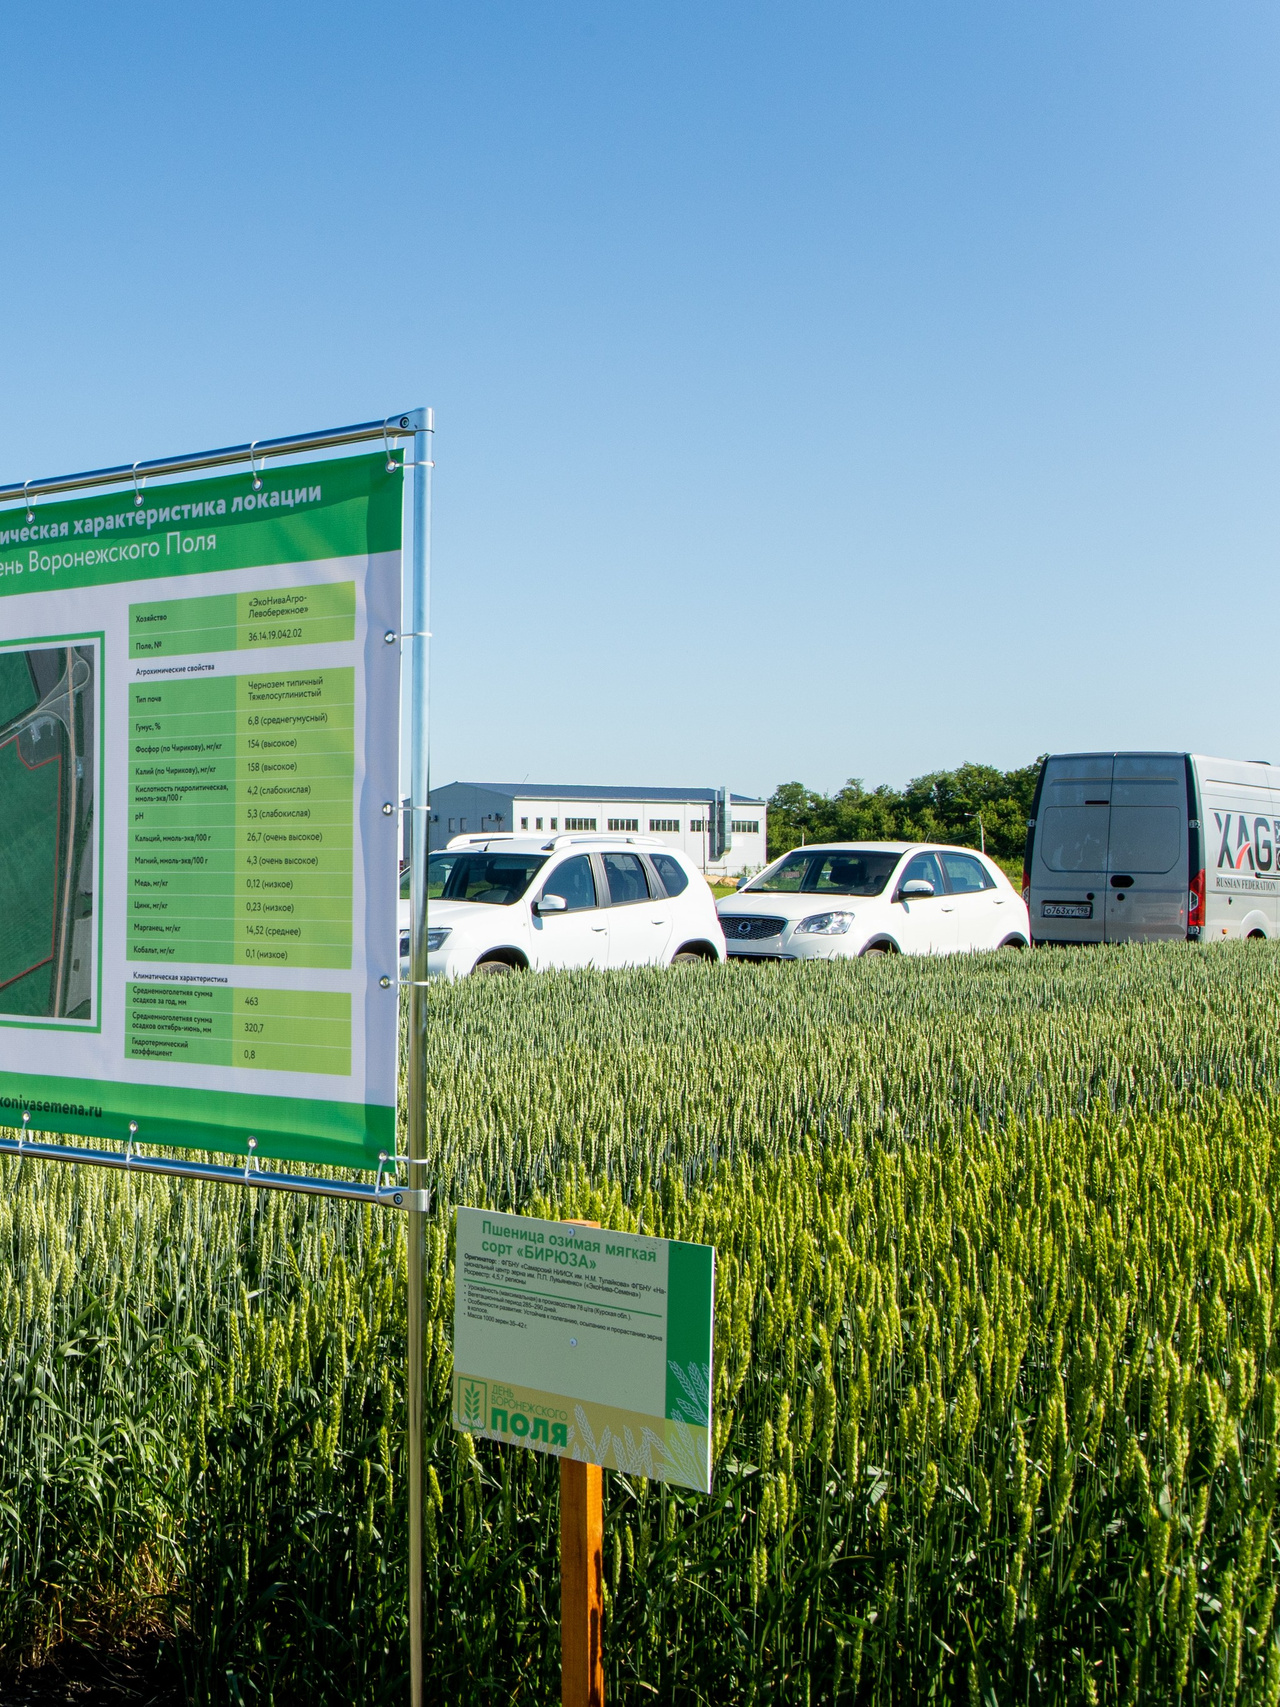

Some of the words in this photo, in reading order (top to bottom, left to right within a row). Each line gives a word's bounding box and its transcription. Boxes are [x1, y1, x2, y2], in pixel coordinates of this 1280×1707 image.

[73, 495, 226, 537] характеристика
[231, 485, 321, 512] локации
[28, 538, 160, 574] Воронежского
[166, 531, 216, 554] Поля
[249, 595, 307, 607] «ЭкоНиваАгро-
[249, 605, 308, 619] Левобережное»
[136, 614, 167, 623] Хозяйство
[249, 629, 302, 641] 36.14.19.042.02
[136, 642, 153, 650] Поле,
[136, 665, 186, 676] Агрохимические
[187, 664, 215, 672] свойства
[248, 681, 285, 690] Чернозем
[286, 677, 323, 686] типичный
[136, 696, 146, 704] Тип
[248, 689, 321, 701] Тяжелосуглинистый
[248, 716, 259, 726] 6,8
[261, 713, 328, 726] (среднегумусный)
[136, 723, 153, 731] Гумус,
[155, 722, 161, 730] %
[136, 744, 159, 753] Фосфор
[161, 744, 170, 754] (по
[172, 743, 204, 753] Чирикову),
[206, 742, 222, 751] мг/кг
[248, 740, 259, 748] 154
[261, 739, 297, 748] (высокое)
[136, 767, 154, 775] Калий
[155, 767, 165, 776] (по
[166, 766, 199, 775] Чирикову),
[201, 766, 216, 774] мг/кг
[248, 763, 260, 771] 158
[261, 762, 297, 772] (высокое)
[136, 784, 173, 792] Кислотность
[175, 784, 228, 792] гидролитическая,
[248, 786, 258, 795] 4,2
[260, 785, 311, 795] (слабокислая)
[135, 812, 144, 821] pH
[248, 809, 257, 818] 5,3
[259, 809, 310, 819] (слабокислая)
[135, 834, 162, 843] Кальций,
[247, 833, 261, 842] 26,7
[263, 832, 287, 842] (очень
[289, 832, 322, 842] высокое)
[1214, 812, 1272, 871] XAG
[135, 857, 159, 865] Магний,
[247, 857, 257, 865] 4,3
[259, 856, 283, 866] (очень
[285, 856, 318, 866] высокое)
[135, 879, 152, 887] Медь,
[153, 879, 168, 887] мг/кг
[247, 879, 260, 888] 0,12
[262, 880, 293, 889] (низкое)
[1216, 877, 1241, 888] RUSSIAN
[1242, 880, 1276, 891] FEDERATION
[134, 902, 152, 910] Цинк,
[152, 902, 168, 910] мг/кг
[246, 903, 261, 912] 0,23
[263, 903, 294, 913] (низкое)
[134, 924, 164, 933] Марганец,
[165, 925, 180, 933] мг/кг
[246, 926, 264, 936] 14,52
[265, 927, 301, 937] (среднее)
[134, 946, 159, 954] Кобальт,
[160, 947, 175, 955] мг/кг
[246, 950, 255, 959] 0,1
[257, 950, 288, 960] (низкое)
[133, 972, 178, 981] Климатическая
[179, 975, 228, 984] характеристика
[133, 986, 193, 997] Среднемноголетняя
[245, 998, 258, 1006] 463
[132, 1012, 192, 1023] Среднемноголетняя
[157, 1023, 202, 1033] октябрь-июнь,
[245, 1024, 264, 1033] 320,7
[132, 1037, 188, 1048] Гидротермический
[132, 1049, 173, 1057] коэффициент
[244, 1051, 255, 1060] 0,8
[483, 1220, 545, 1244] Пшеница
[549, 1234, 601, 1253] озимая
[605, 1244, 656, 1263] мягкая
[482, 1240, 512, 1256] сорт
[517, 1245, 596, 1270] «БИРЮЗА»
[492, 1384, 514, 1398] ДЕНЬ
[491, 1395, 567, 1421] ВОРОНЕЖСКОГО
[491, 1407, 568, 1447] ПОЛЯ
